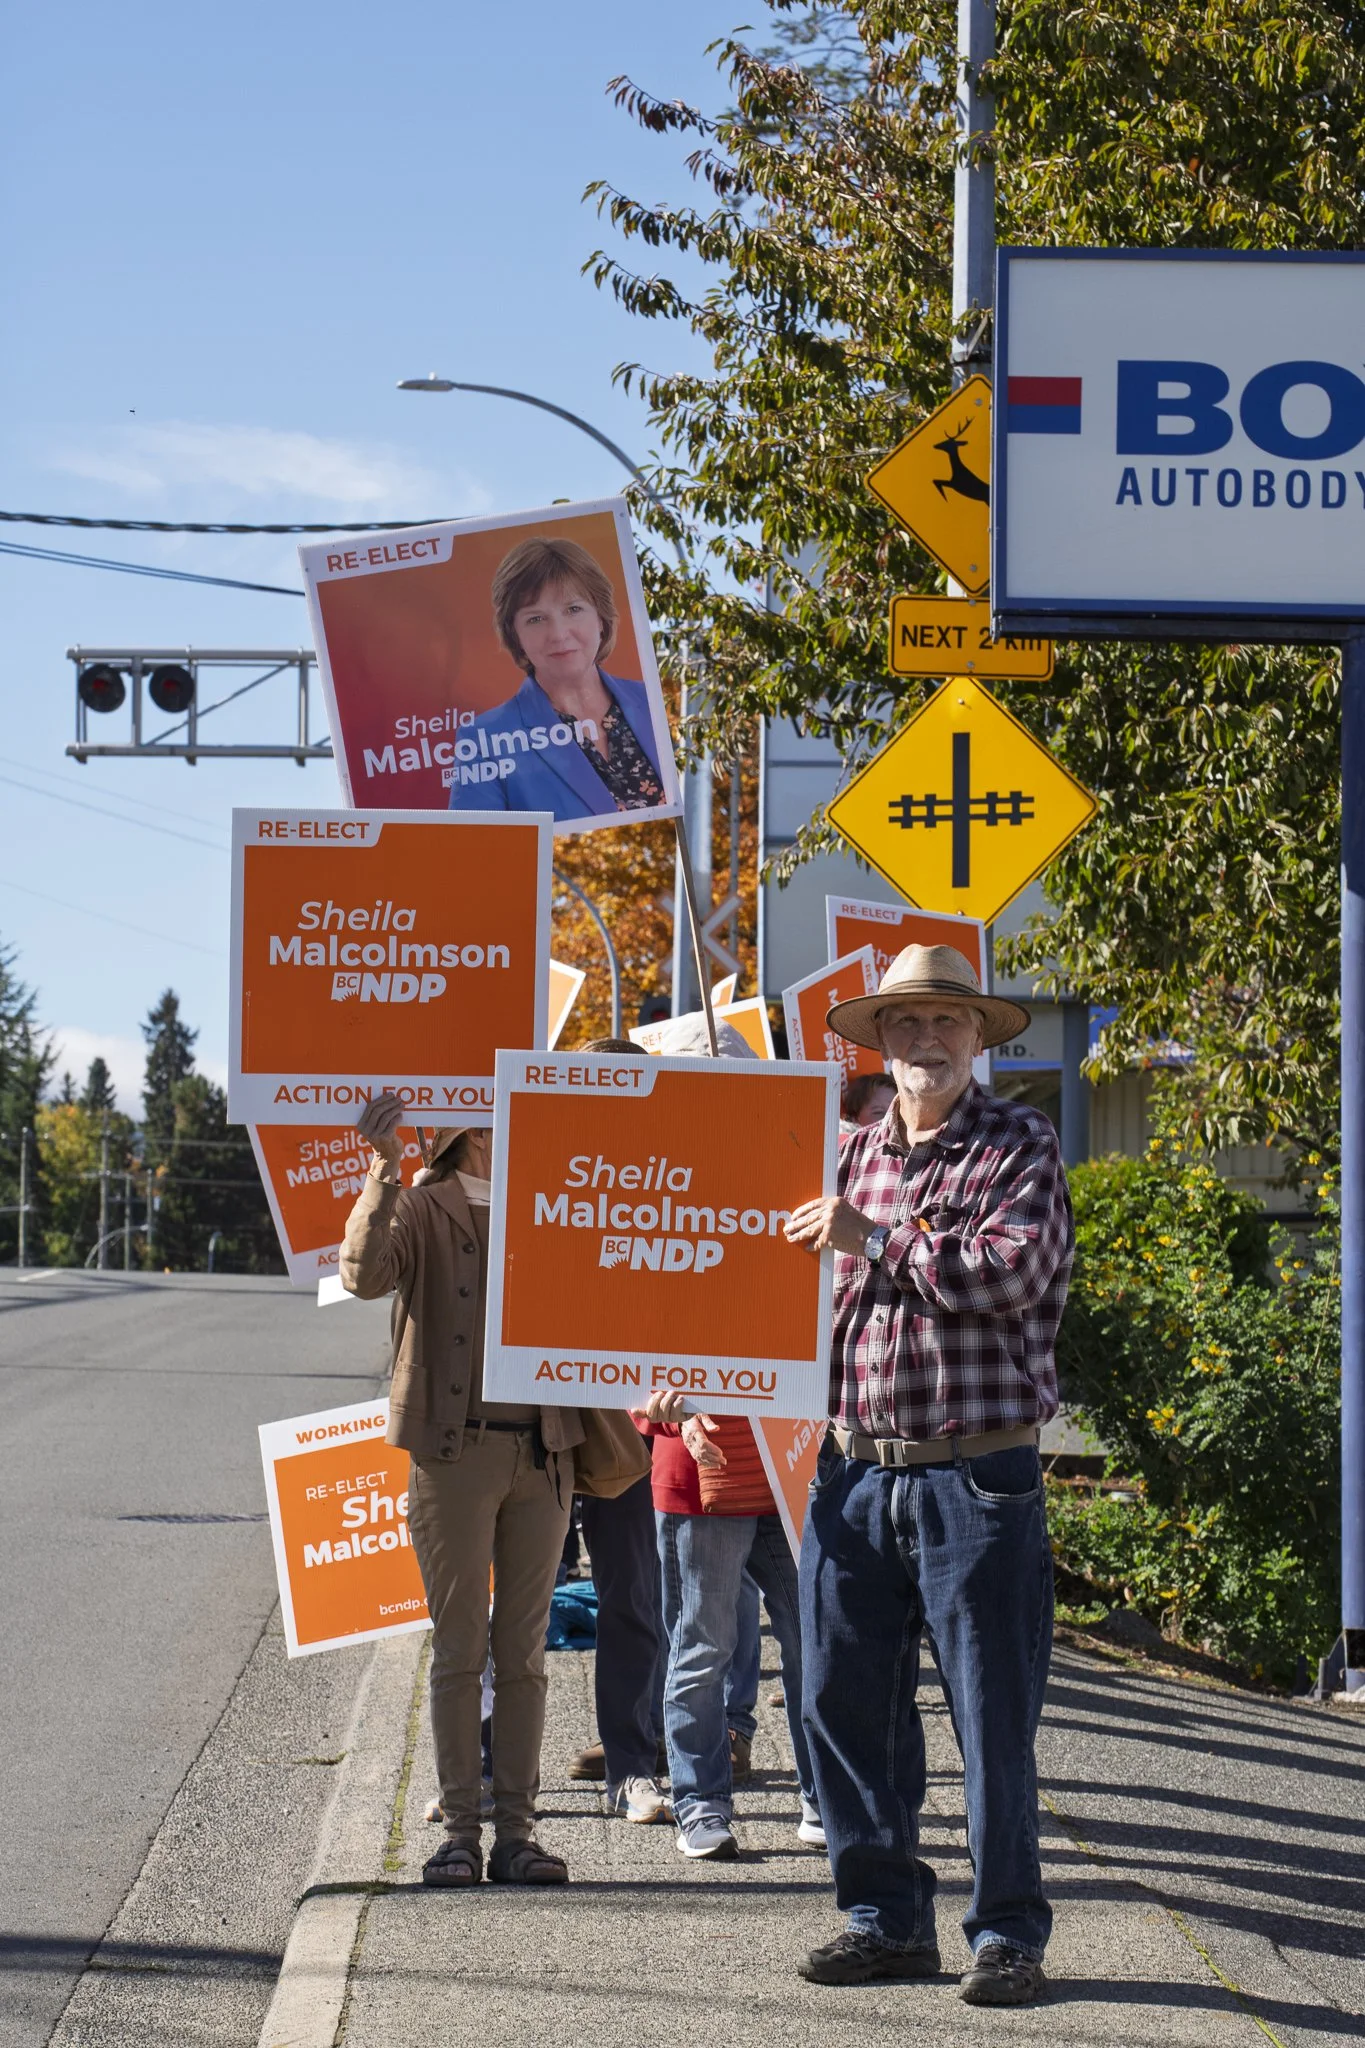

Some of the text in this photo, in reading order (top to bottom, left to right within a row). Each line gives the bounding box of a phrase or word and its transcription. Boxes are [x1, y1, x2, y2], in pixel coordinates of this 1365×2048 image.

[1116, 359, 1365, 461] BO
[327, 538, 441, 572] RE-ELECT
[901, 625, 968, 649] NEXT
[394, 708, 475, 739] Sheila
[362, 717, 599, 779] Malcolmson
[459, 758, 516, 786] NDP
[258, 821, 370, 840] RE-ELECT
[297, 900, 417, 931] Sheila
[842, 904, 897, 921] RE-ELECT
[269, 934, 510, 969] Malcolmson
[336, 972, 447, 1004] BC NDP
[525, 1066, 644, 1088] RE-ELECT
[273, 1085, 372, 1105] ACTION
[442, 1087, 495, 1106] YOU
[564, 1155, 692, 1192] Sheila
[534, 1193, 792, 1237] Malcolmson
[605, 1237, 724, 1273] BC NDP
[535, 1360, 777, 1393] ACTION FOR YOU
[296, 1415, 386, 1444] WORKING
[306, 1471, 388, 1501] RE-ELECT
[342, 1490, 409, 1528] She
[303, 1523, 413, 1568] Malcol
